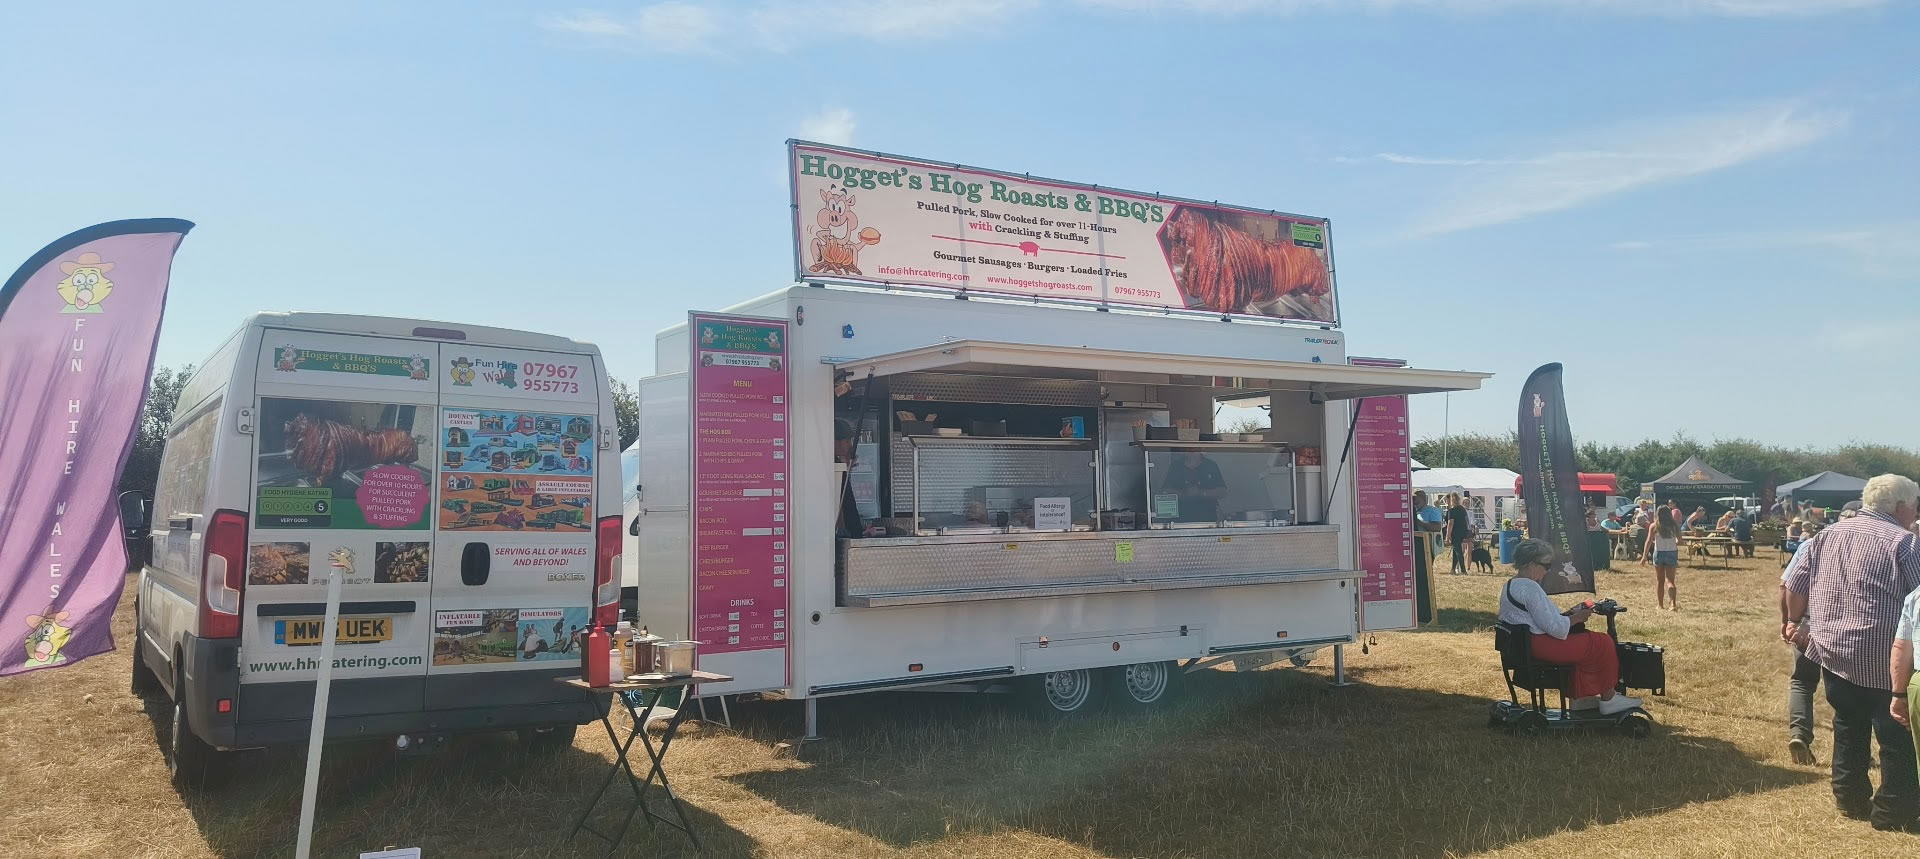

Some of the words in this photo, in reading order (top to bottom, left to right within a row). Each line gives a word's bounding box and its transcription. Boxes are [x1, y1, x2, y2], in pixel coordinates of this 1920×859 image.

[800, 154, 923, 190] Hogget's
[928, 172, 983, 203] Hog
[990, 181, 1069, 209] Roasts
[1074, 193, 1092, 212] &
[1097, 195, 1164, 223] BBQ'S
[917, 201, 950, 213] Pulled
[952, 205, 979, 218] Pork,
[980, 209, 1002, 220] Slow
[1003, 213, 1037, 225] Cooked
[1040, 217, 1054, 226] for
[1056, 221, 1076, 229] over
[1078, 221, 1117, 234] 11-Hours
[969, 221, 993, 232] with
[995, 225, 1042, 239] Crackling
[1044, 230, 1051, 238] &
[1053, 231, 1090, 244] Stuffing
[933, 250, 977, 264] Gourmet
[978, 256, 1022, 269] Sausages
[1027, 261, 1065, 273] Burgers
[1070, 265, 1103, 276] Loaded
[1104, 268, 1128, 279] Fries
[878, 265, 970, 281] info@hhrcatering.com
[987, 276, 1093, 292] www.hoggetshogroasts.com
[1114, 286, 1136, 296] 07967
[1137, 288, 1161, 299] 955773
[71, 318, 86, 372] FUN
[301, 351, 347, 362] Hogget's
[349, 353, 370, 364] Hog
[374, 355, 408, 365] Roasts
[475, 358, 494, 368] Fun
[497, 360, 518, 370] Hire
[333, 362, 342, 370] &
[344, 363, 378, 373] BBQ'S
[523, 362, 579, 379] 07967
[482, 369, 514, 383] Wal
[523, 379, 579, 394] 955773
[64, 399, 80, 475] HIRE
[372, 472, 390, 480] SLOW
[390, 473, 416, 482] COOKED
[376, 480, 393, 488] OVER
[401, 482, 423, 490] HOURS
[381, 489, 416, 497] SUCCULENT
[318, 503, 324, 511] 5
[372, 497, 395, 505] PULLED
[395, 498, 412, 506] PORK
[382, 506, 416, 515] CRACKLING
[379, 514, 408, 522] STUFFING
[50, 501, 66, 599] WALES
[495, 548, 531, 556] SERVING
[532, 548, 547, 556] ALL
[548, 548, 560, 556] OF
[561, 547, 587, 556] WALES
[532, 558, 569, 566] BEYOND!
[311, 577, 372, 585] PEEOT
[547, 573, 586, 582] BOXER
[730, 598, 754, 607] DRINKS
[293, 621, 340, 640] MW
[346, 619, 385, 638] UEK
[250, 655, 422, 672] www.hhatering.com
